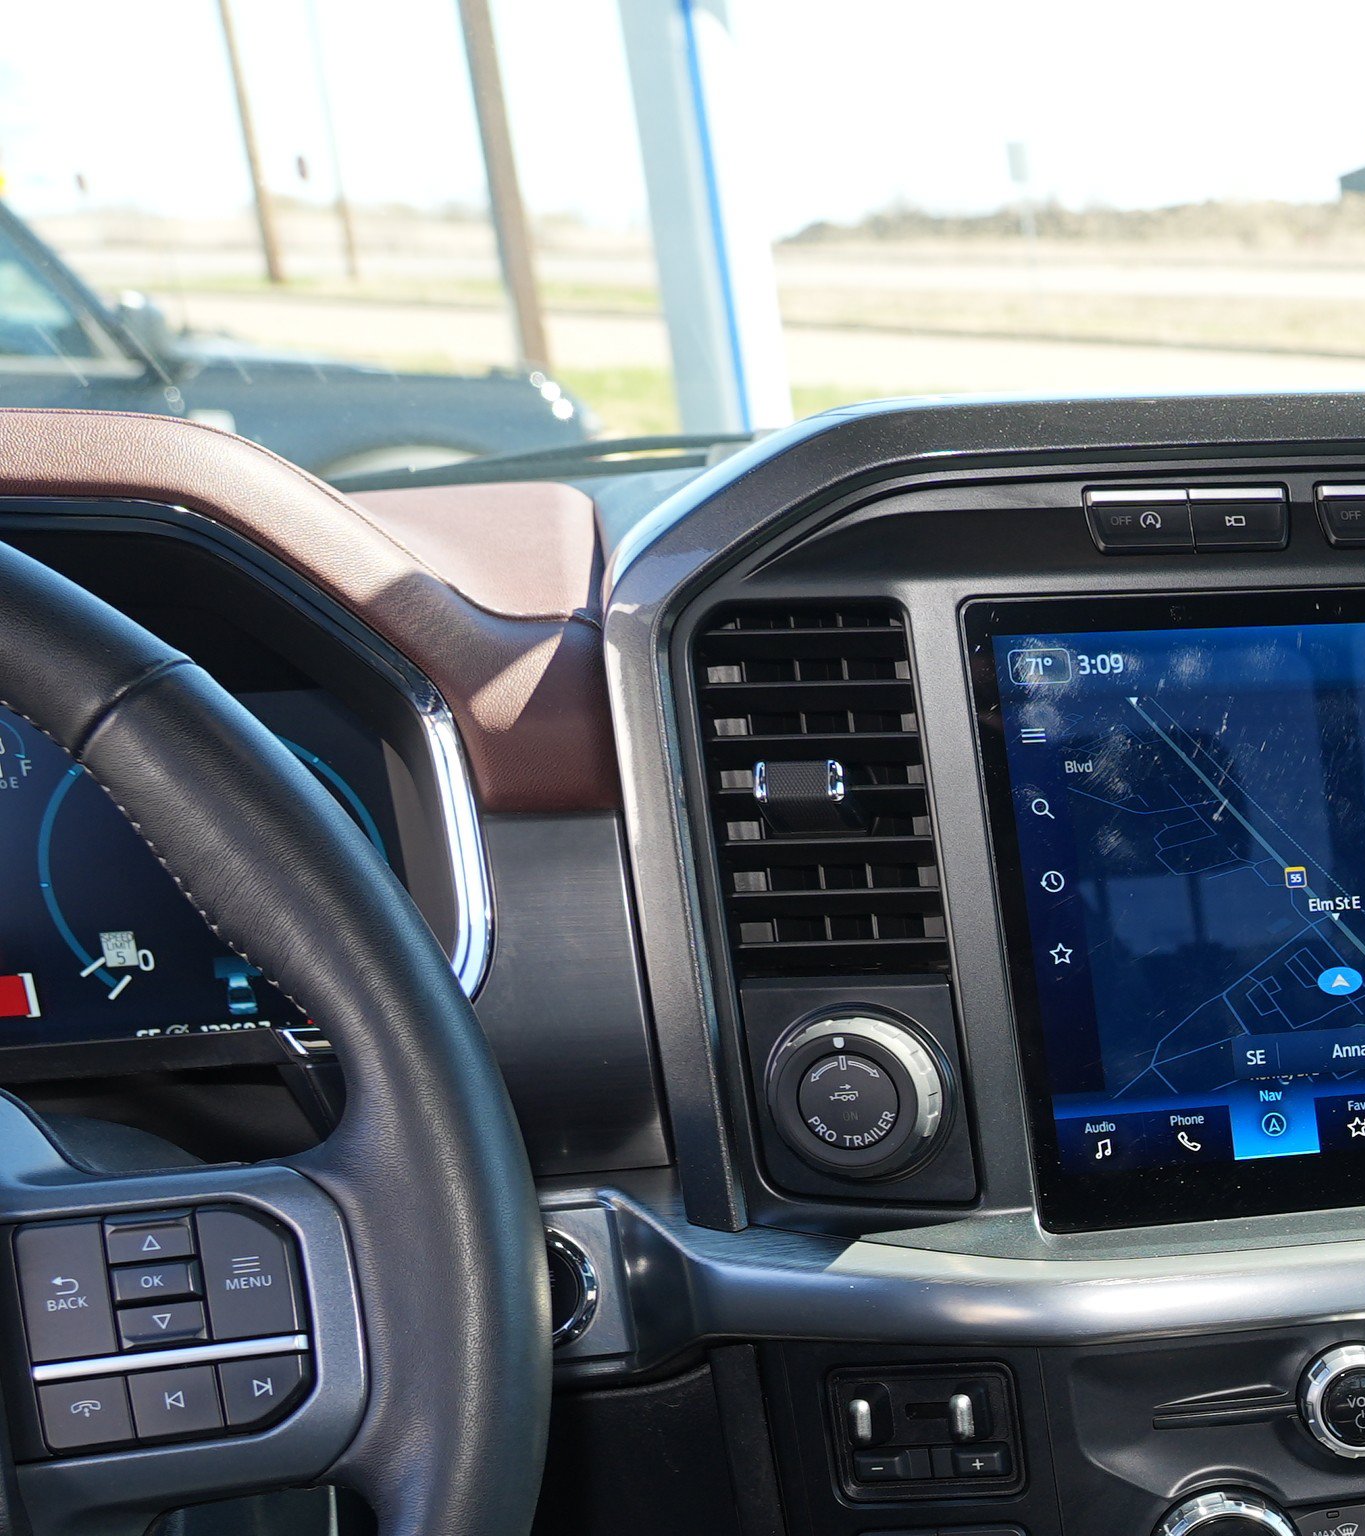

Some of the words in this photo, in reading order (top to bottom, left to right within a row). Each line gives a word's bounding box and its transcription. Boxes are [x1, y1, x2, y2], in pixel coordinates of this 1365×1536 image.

[1110, 515, 1132, 526] OFF
[1340, 510, 1362, 521] OFF
[1025, 657, 1053, 676] 71°
[1077, 653, 1124, 675] 3:09
[21, 759, 33, 777] F
[1064, 759, 1093, 774] Blvd
[1290, 873, 1302, 883] 55
[1308, 897, 1335, 912] Elm
[1335, 896, 1350, 911] St
[1351, 896, 1361, 910] E
[100, 931, 134, 942] SPEED
[106, 941, 132, 952] LIMIT
[116, 951, 126, 965] 5
[138, 948, 155, 972] 0
[1246, 1049, 1266, 1066] SE
[1259, 1089, 1283, 1102] Nav
[842, 1111, 859, 1121] ON
[1169, 1113, 1205, 1127] Phone
[807, 1115, 837, 1142] PRO
[843, 1109, 896, 1147] TRAILER
[1084, 1120, 1116, 1134] Audio
[140, 1274, 164, 1288] OK
[225, 1274, 273, 1292] MENU
[46, 1295, 89, 1312] BACK
